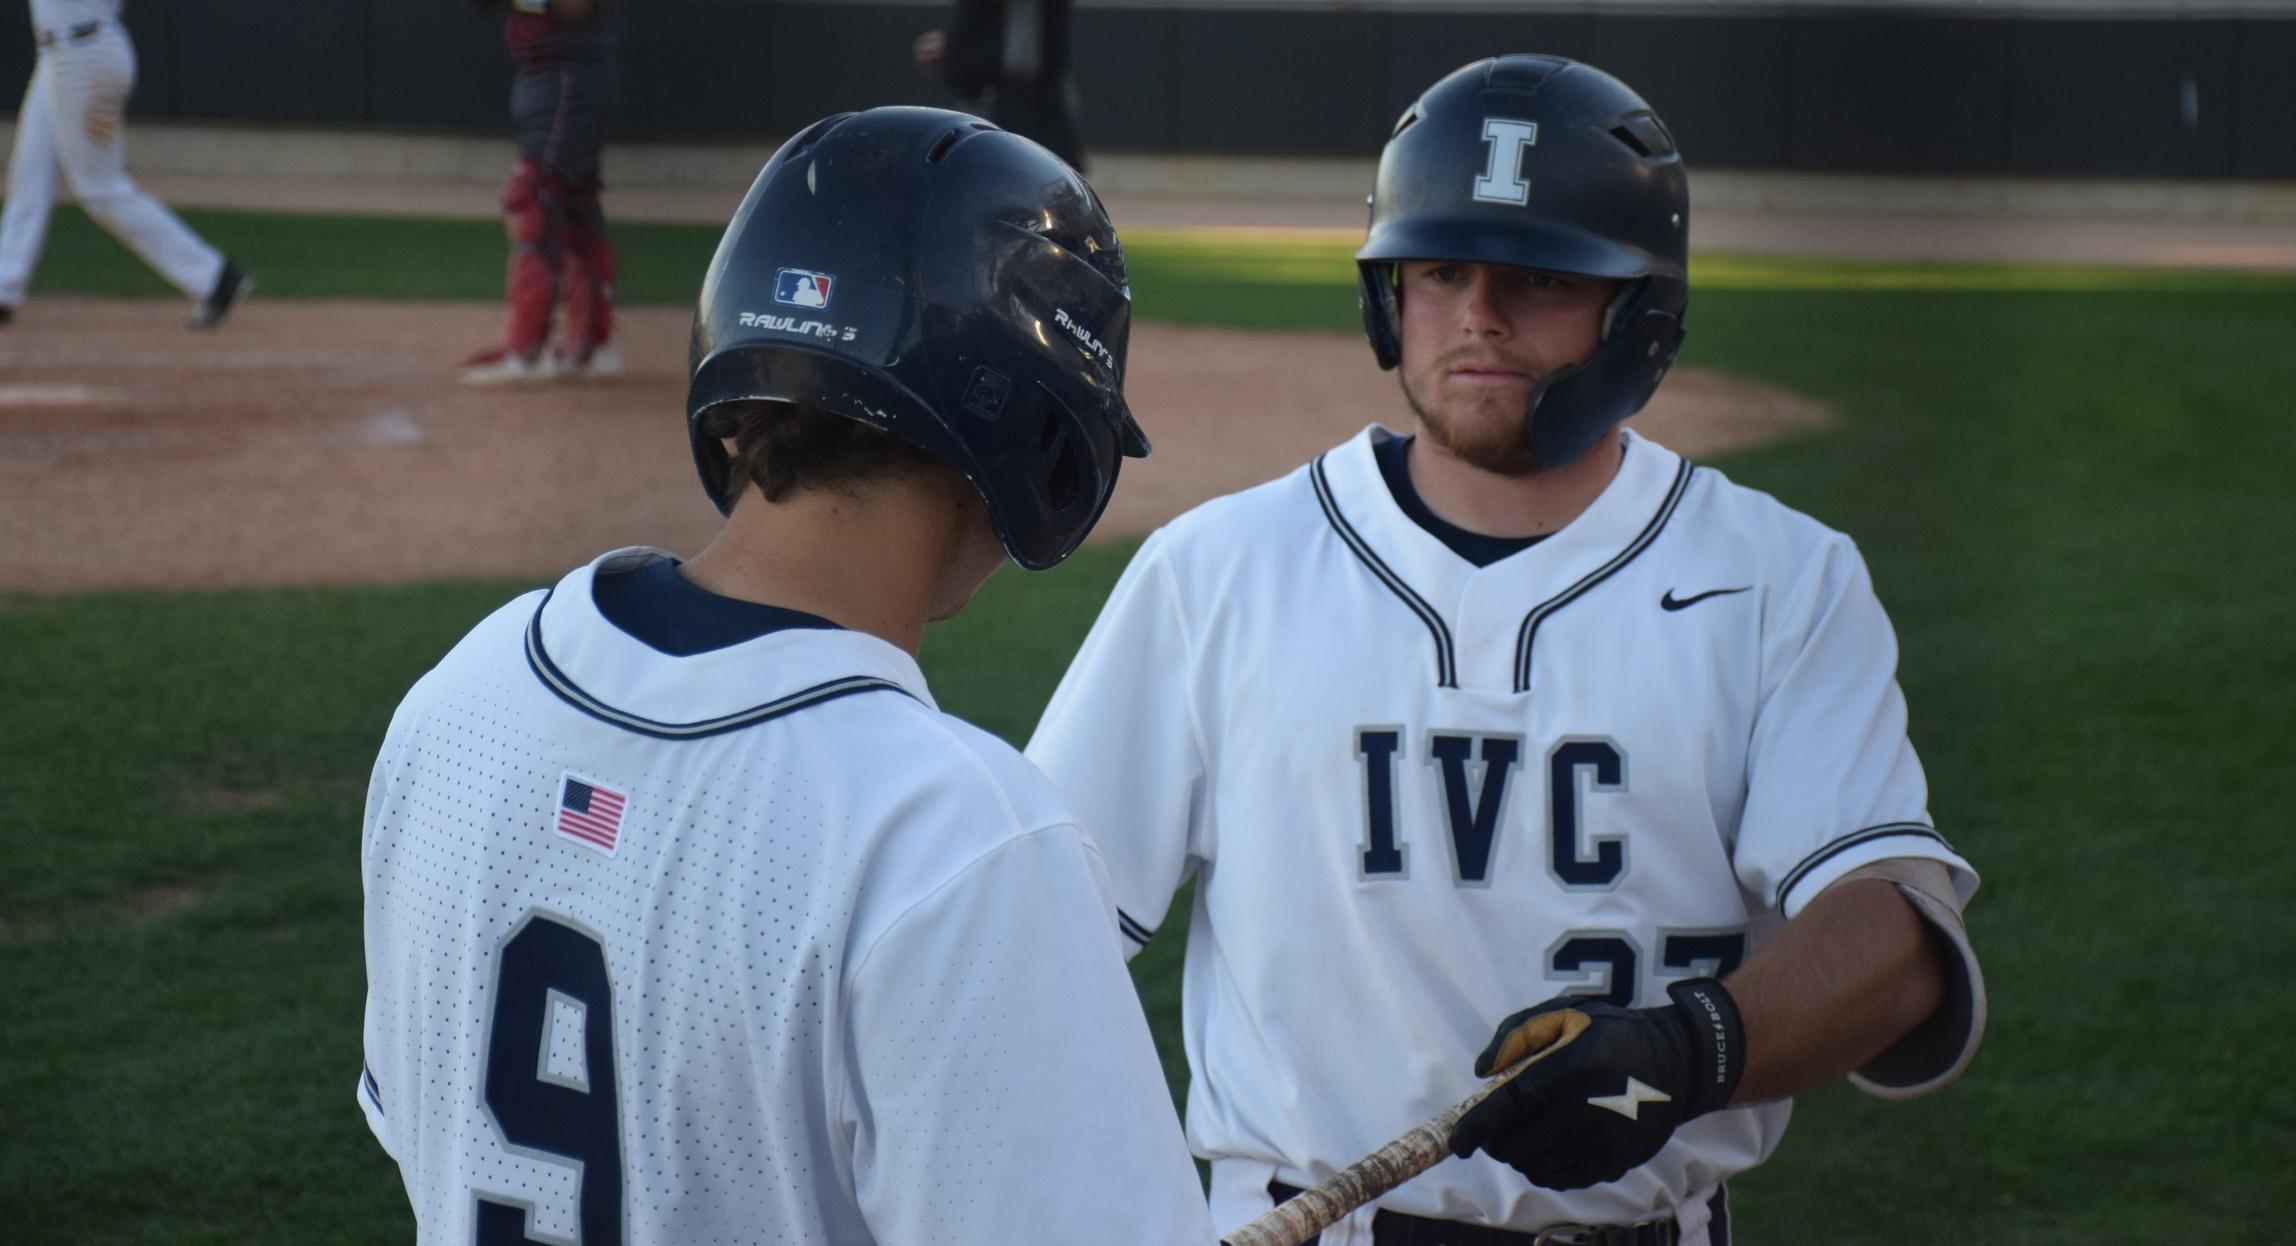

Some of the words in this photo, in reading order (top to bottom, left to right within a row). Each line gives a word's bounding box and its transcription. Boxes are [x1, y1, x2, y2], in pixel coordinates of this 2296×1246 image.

[1473, 117, 1537, 206] I
[1353, 724, 1631, 894] IVC
[468, 905, 630, 1246] 9
